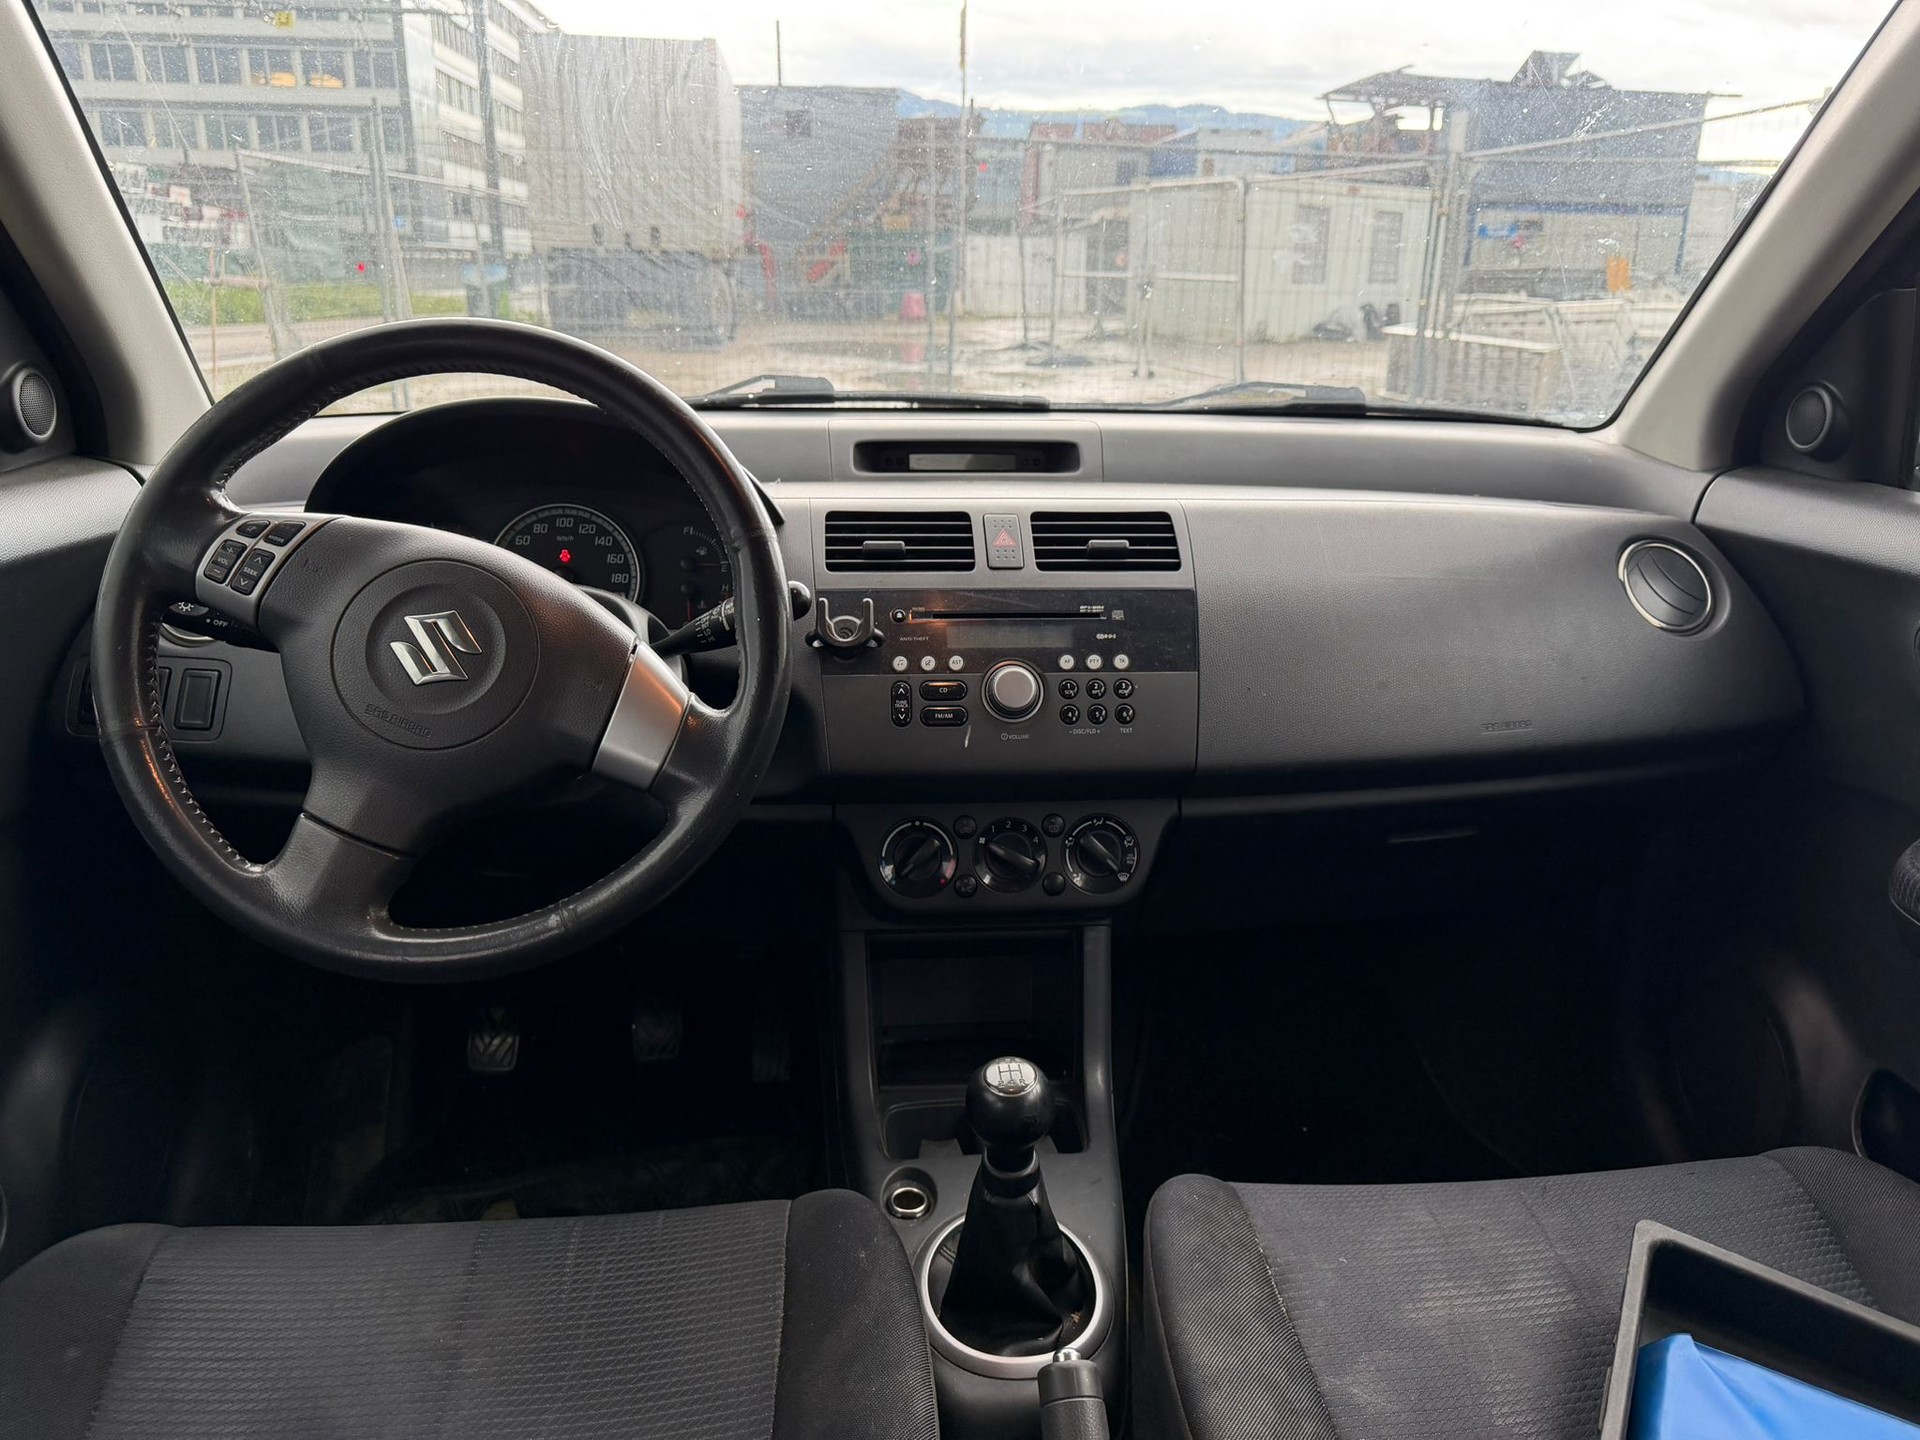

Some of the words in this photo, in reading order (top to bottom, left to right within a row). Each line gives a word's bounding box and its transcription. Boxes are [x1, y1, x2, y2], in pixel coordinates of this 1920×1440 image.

[556, 517, 574, 528] 100
[533, 523, 549, 534] 80
[578, 523, 597, 534] 120
[682, 526, 690, 535] F
[515, 535, 531, 546] 60
[594, 535, 613, 547] 140
[217, 556, 229, 566] VOL
[607, 553, 625, 564] 160
[242, 566, 259, 577] SEEK
[611, 573, 630, 584] 180
[721, 584, 729, 592] H
[213, 619, 229, 628] OFF
[991, 825, 995, 833] 1
[1006, 820, 1012, 829] 2
[1022, 825, 1028, 833] 3
[1032, 836, 1039, 844] 4
[1019, 1078, 1028, 1087] R
